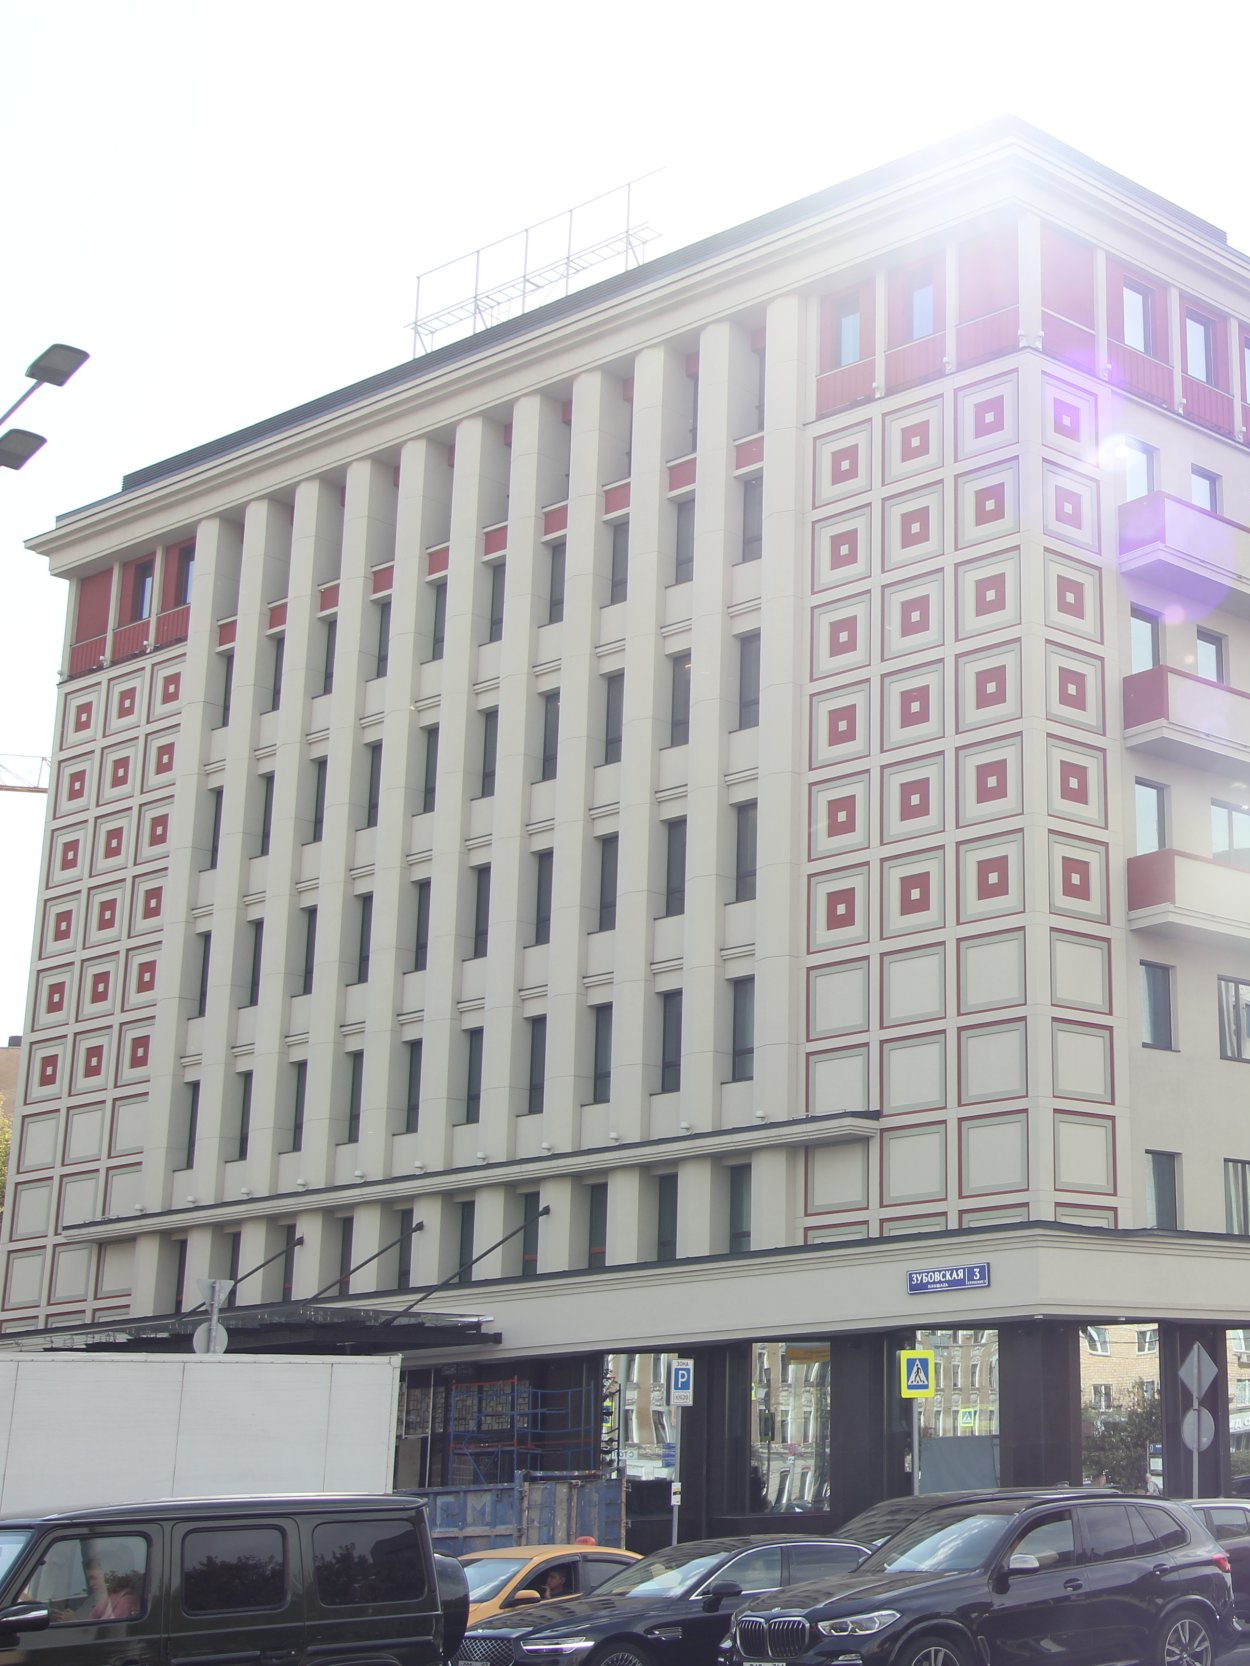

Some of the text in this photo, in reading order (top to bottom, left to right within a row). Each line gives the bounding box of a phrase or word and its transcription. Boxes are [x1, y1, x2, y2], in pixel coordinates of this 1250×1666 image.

[911, 1268, 980, 1285] ЗУБОВСКАЯ 3
[678, 1370, 688, 1388] P
